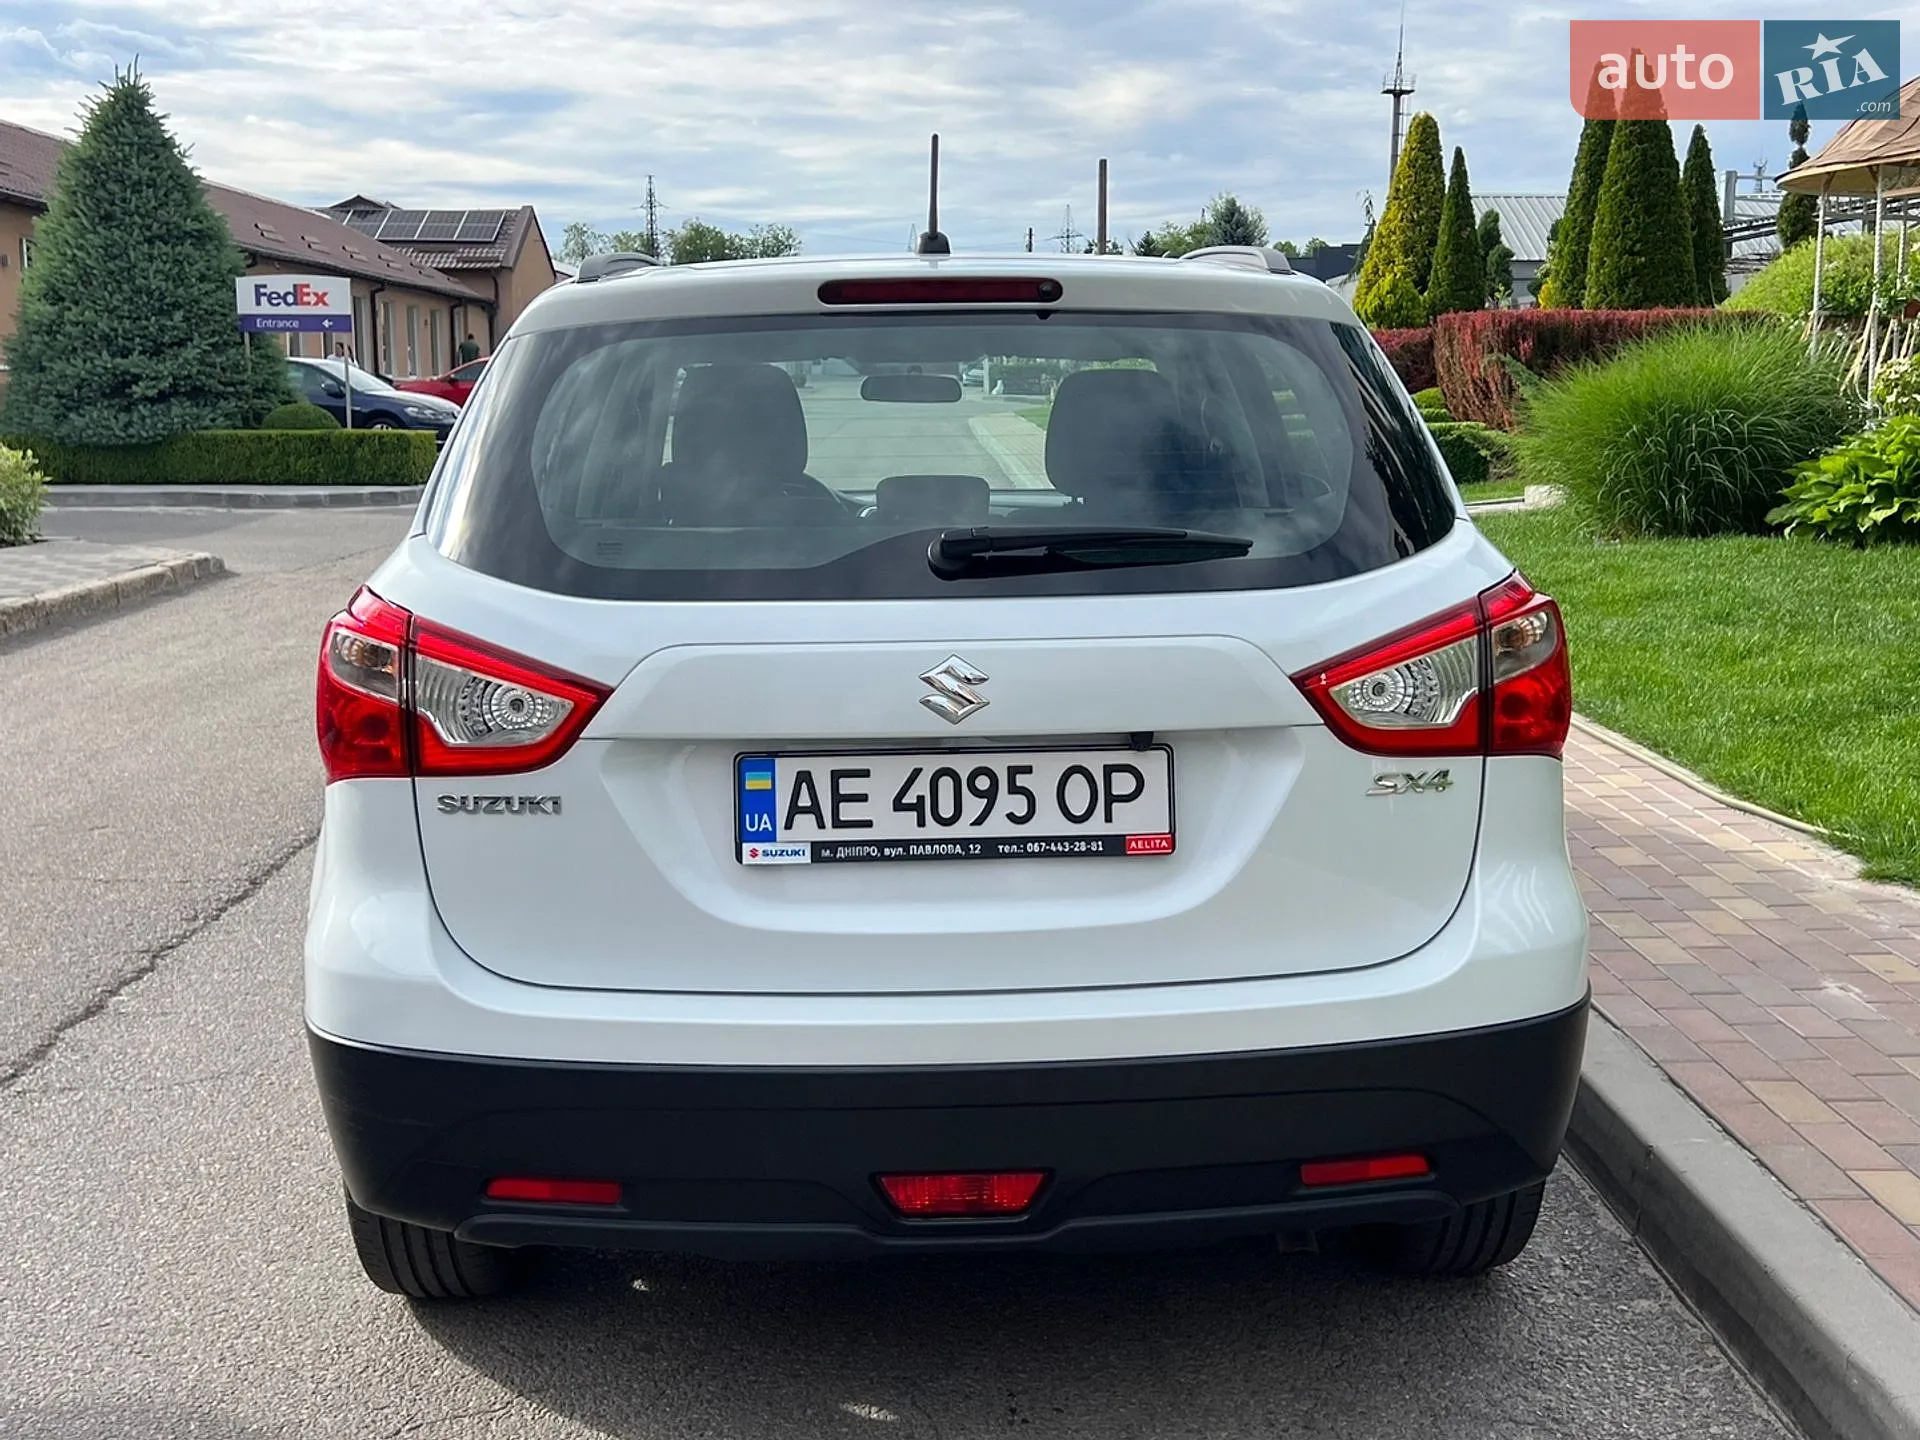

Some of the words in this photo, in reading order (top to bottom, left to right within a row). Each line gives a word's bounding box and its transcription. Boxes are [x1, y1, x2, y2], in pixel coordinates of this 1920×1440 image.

[254, 283, 329, 307] FedEx
[256, 318, 299, 329] Entrance
[1365, 768, 1454, 796] SX4
[437, 794, 562, 815] SUZUKI
[784, 768, 873, 831] AE
[892, 765, 1036, 828] 4095
[1056, 763, 1145, 824] OP
[745, 813, 773, 832] UA
[762, 848, 806, 857] SUZUKI
[821, 848, 833, 857] м.
[836, 846, 881, 858] ДНІПРО,
[884, 847, 906, 857] вул.
[909, 844, 966, 857] ПАВЛОВА,
[968, 844, 981, 854] 12
[998, 844, 1024, 854] тел.:
[1129, 839, 1169, 850] AELITA
